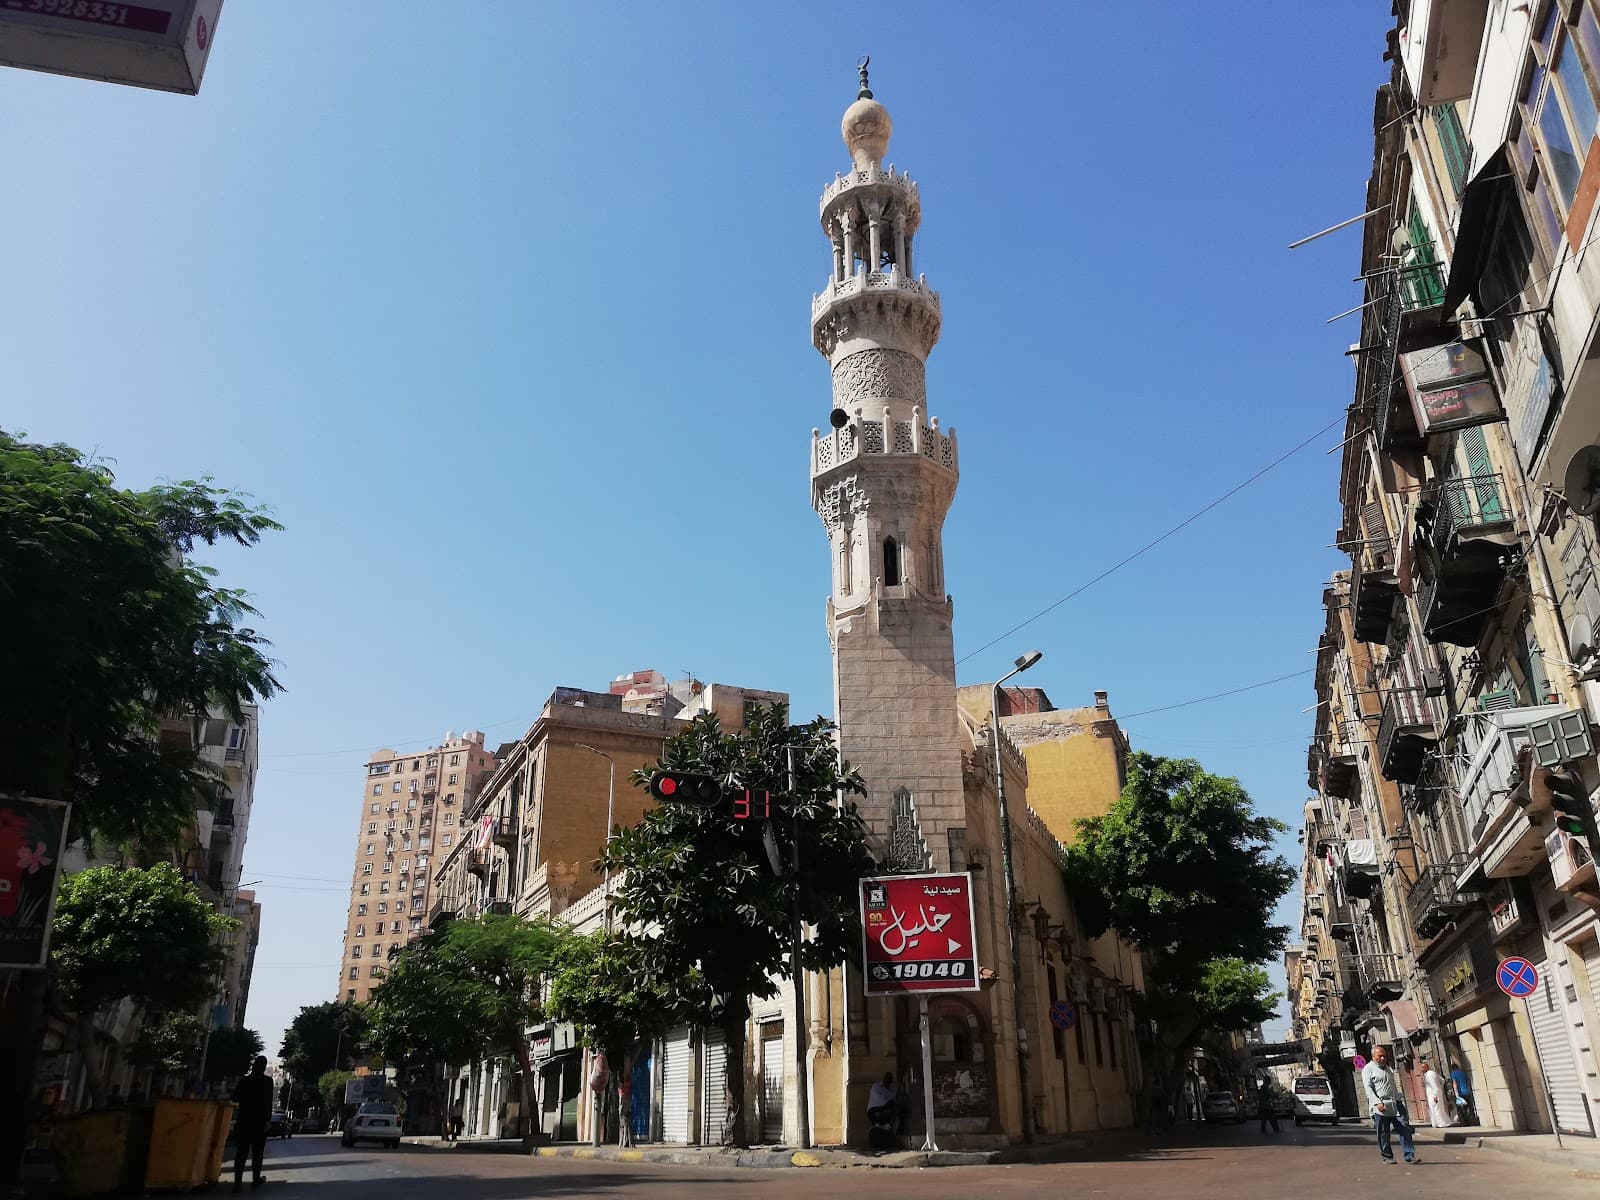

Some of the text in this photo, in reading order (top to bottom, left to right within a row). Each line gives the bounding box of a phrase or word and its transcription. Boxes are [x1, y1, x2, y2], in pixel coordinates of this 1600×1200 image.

[734, 786, 770, 819] 31
[869, 912, 883, 923] 90
[880, 904, 952, 955] خليل
[892, 962, 966, 979] 19040
